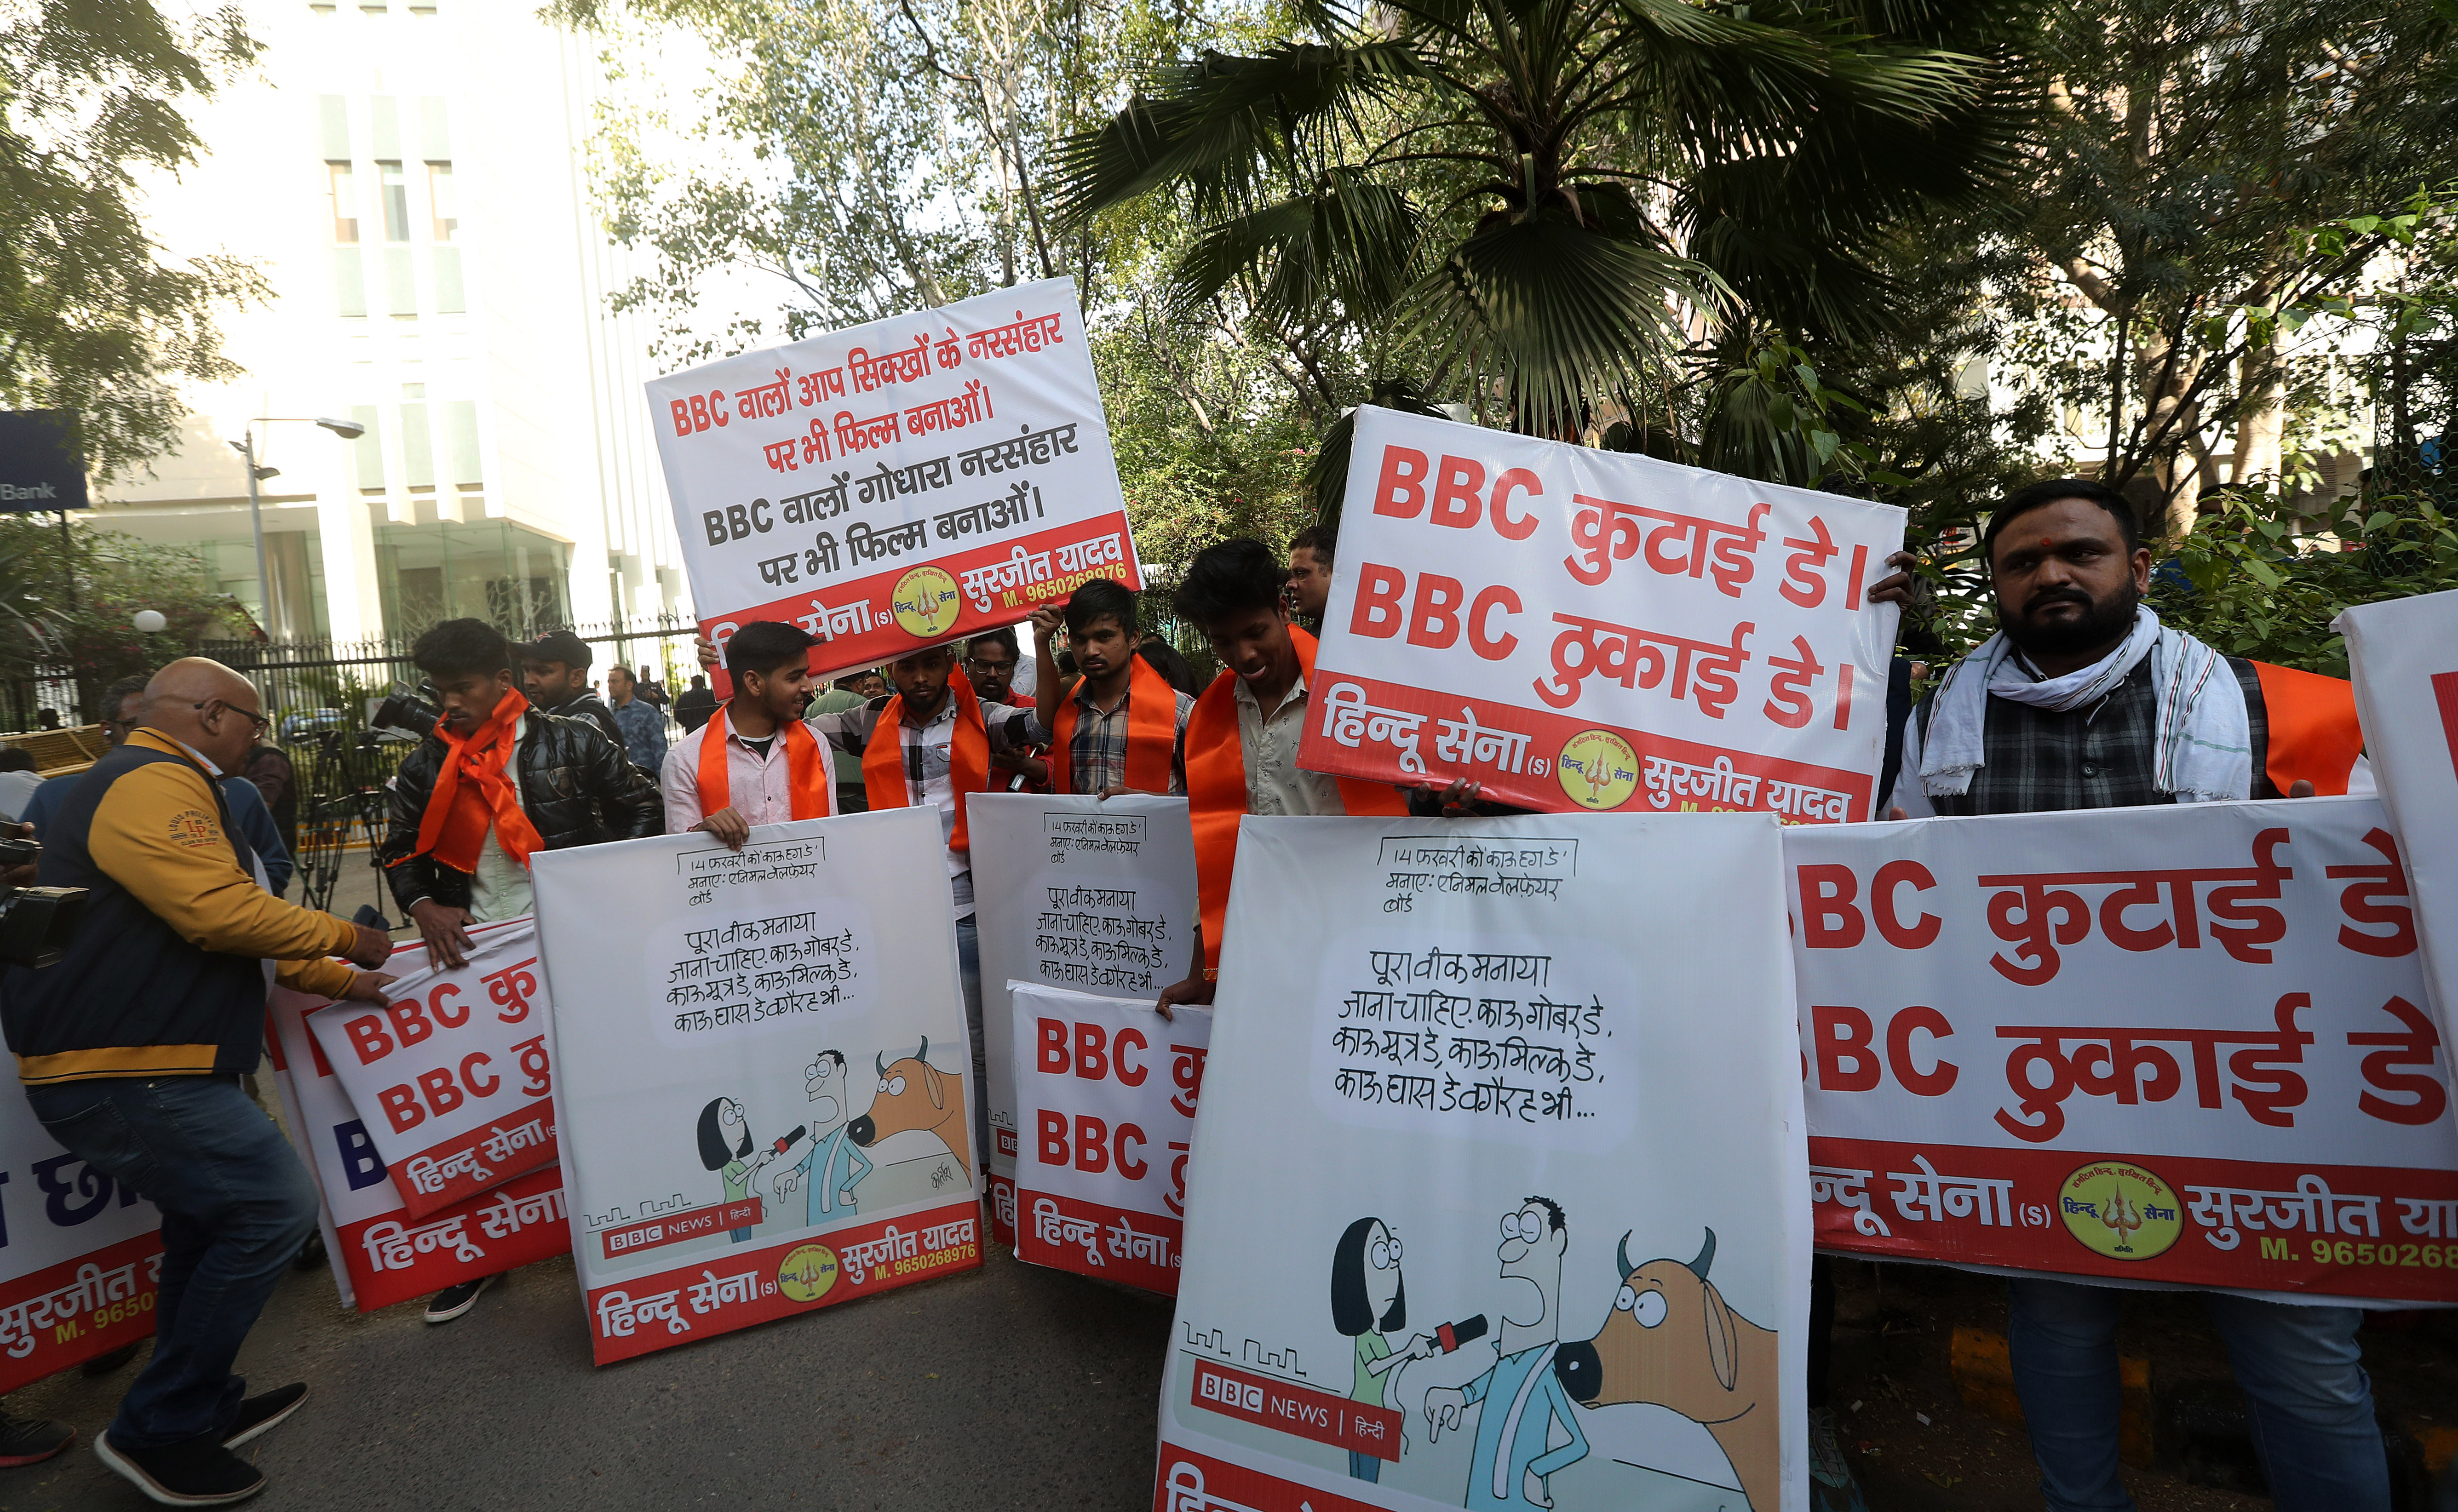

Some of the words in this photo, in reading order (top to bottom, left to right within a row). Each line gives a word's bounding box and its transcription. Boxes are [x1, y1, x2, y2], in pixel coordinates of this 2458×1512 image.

[671, 390, 729, 436] BBC
[735, 367, 792, 419] वालों
[798, 367, 845, 406] आप
[848, 333, 931, 393] सिक्खों
[934, 327, 961, 369] के
[966, 310, 1063, 359] नरसंहार
[764, 439, 798, 473] पर
[802, 418, 831, 464] भी
[834, 411, 901, 456] फिल्म
[0, 482, 57, 500] Bank
[703, 498, 773, 546] BBC
[780, 471, 850, 524] वालों
[855, 456, 952, 503] गोधारा
[957, 423, 1078, 476] नरसंहार
[1373, 445, 1543, 540] BBC
[1564, 494, 1771, 598] कुटाई
[758, 553, 798, 586] पर
[805, 532, 840, 575] भी
[845, 519, 927, 566] फिल्म
[960, 545, 1052, 613] सुरजीत
[1056, 533, 1123, 572] यादव
[895, 601, 915, 613] हिन्दू
[940, 591, 955, 602] सेना
[1003, 590, 1023, 607] M.
[1027, 563, 1126, 601] 9650268976
[797, 599, 872, 641] सेना
[1350, 562, 1522, 660] BBC
[1533, 613, 1755, 719] ठुकाई
[1322, 682, 1428, 774] हिन्दू
[1436, 706, 1534, 774] सेना
[1562, 755, 1583, 773] हिन्दू
[1615, 767, 1634, 781] सेना
[1644, 756, 1761, 808] सुरजीत
[1767, 779, 1853, 823] यादव
[1053, 822, 1061, 832] 14
[1088, 819, 1096, 834] को
[1115, 824, 1128, 835] हग
[1075, 837, 1100, 852] एनिमल
[692, 861, 704, 871] 14
[748, 850, 760, 865] को
[786, 848, 802, 860] हग
[729, 870, 765, 884] एनिमल
[1051, 850, 1065, 863] बोर्ड
[1395, 849, 1411, 865] 14
[1467, 845, 1484, 867] को
[1520, 851, 1543, 867] हग
[689, 889, 712, 905] बोर्ड
[1384, 893, 1412, 912] बोर्ड
[1438, 872, 1488, 895] एनिमल
[1789, 860, 1941, 949] BC
[1979, 828, 2292, 985] कुटाई
[684, 929, 719, 954] पूरा
[722, 921, 759, 943] वीक
[758, 912, 816, 935] मनाया
[668, 957, 710, 983] जाना
[770, 943, 802, 963] काऊ
[804, 936, 839, 957] गोबर
[1370, 951, 1412, 986] पूरा
[1414, 946, 1467, 984] वीक
[1467, 954, 1551, 987] मनाया
[667, 985, 705, 1006] काऊ
[706, 978, 734, 1002] मूत्र
[755, 971, 790, 991] काऊ
[786, 964, 836, 985] मिल्क
[344, 983, 470, 1065] BBC
[675, 1010, 712, 1032] काऊ
[714, 1003, 750, 1025] घास
[754, 997, 766, 1021] डे
[766, 990, 818, 1016] वगैरह
[1338, 991, 1394, 1021] जाना
[1478, 999, 1523, 1031] काऊ
[1526, 994, 1582, 1039] गोबर
[1038, 1018, 1148, 1086] BBC
[1333, 1026, 1379, 1057] काऊ
[1381, 1031, 1419, 1066] मूत्र
[1449, 1038, 1499, 1070] काऊ
[1496, 1036, 1571, 1083] मिल्क
[1798, 1006, 1958, 1096] BC
[1995, 993, 2314, 1142] ठुकाई
[378, 1052, 500, 1134] BBC
[1335, 1068, 1382, 1104] काऊ
[1387, 1074, 1435, 1111] घास
[1440, 1071, 1460, 1111] डे
[1459, 1076, 1537, 1123] वगैरह
[407, 1147, 494, 1194] हिन्दू
[481, 1118, 545, 1162] सेना
[1038, 1109, 1147, 1180] BBC
[730, 1207, 751, 1221] हिन्दी
[1887, 1154, 2013, 1226] सेना
[2063, 1197, 2100, 1218] हिन्दू
[2144, 1204, 2175, 1220] सेना
[2188, 1174, 2380, 1251] सुरजीत
[362, 1214, 485, 1272] हिन्दू
[481, 1190, 568, 1240] सेना
[614, 1228, 660, 1248] BBC
[668, 1216, 712, 1236] NEWS
[841, 1226, 917, 1284] सुरजीत
[922, 1219, 974, 1250] यादव
[1033, 1198, 1105, 1266] हिन्दू
[1106, 1216, 1169, 1266] सेना
[2261, 1237, 2298, 1260] M.
[875, 1266, 890, 1280] M.
[895, 1244, 975, 1275] 9650268976
[0, 1263, 135, 1358] सुरजीत
[597, 1289, 690, 1337] हिन्दू
[687, 1270, 758, 1314] सेना
[56, 1321, 85, 1344] M.
[1205, 1377, 1259, 1408] BBC
[1271, 1395, 1328, 1427] NEWS
[1355, 1416, 1385, 1440] हिन्दी
